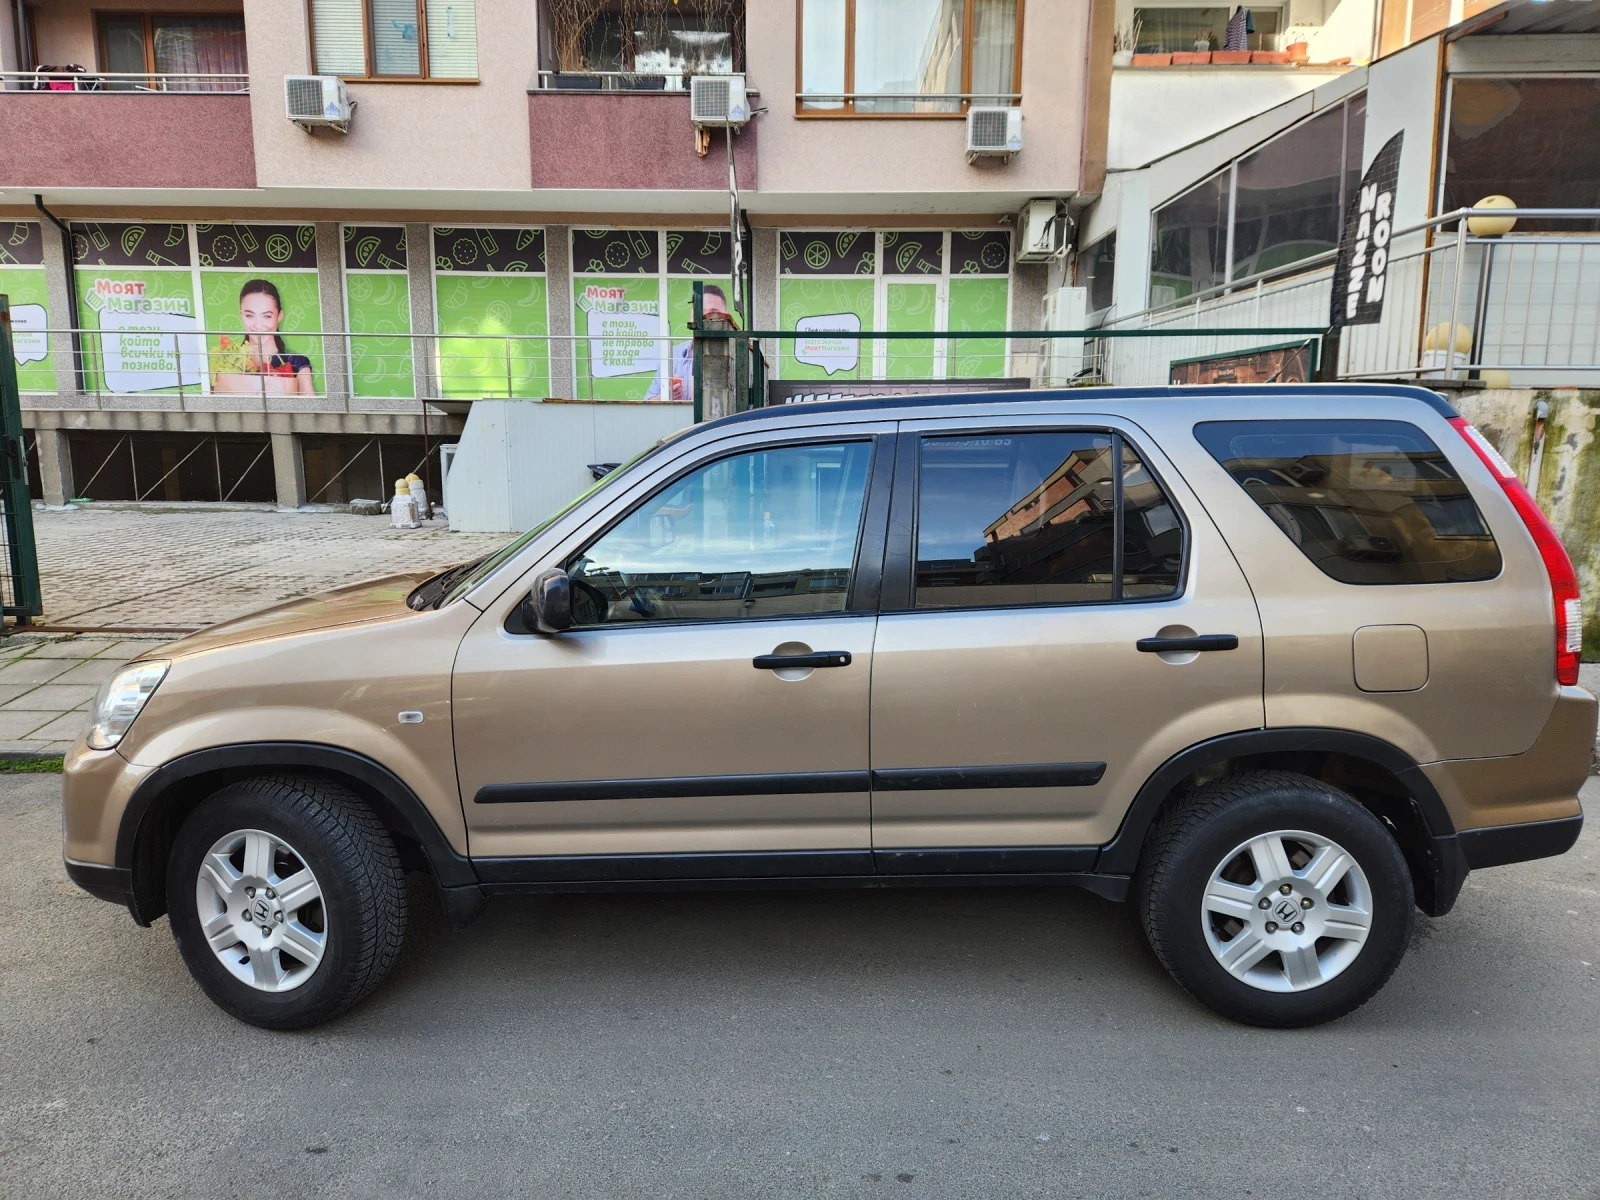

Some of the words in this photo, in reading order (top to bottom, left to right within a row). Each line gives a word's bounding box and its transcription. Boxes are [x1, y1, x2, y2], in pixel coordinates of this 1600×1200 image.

[1346, 182, 1378, 319] MAZZE
[1366, 191, 1392, 303] ROOM
[96, 280, 145, 295] Моят
[587, 287, 625, 299] Моят
[107, 296, 189, 312] Магазин
[594, 300, 659, 312] Магазин
[120, 335, 161, 347] който
[122, 359, 177, 371] познава.
